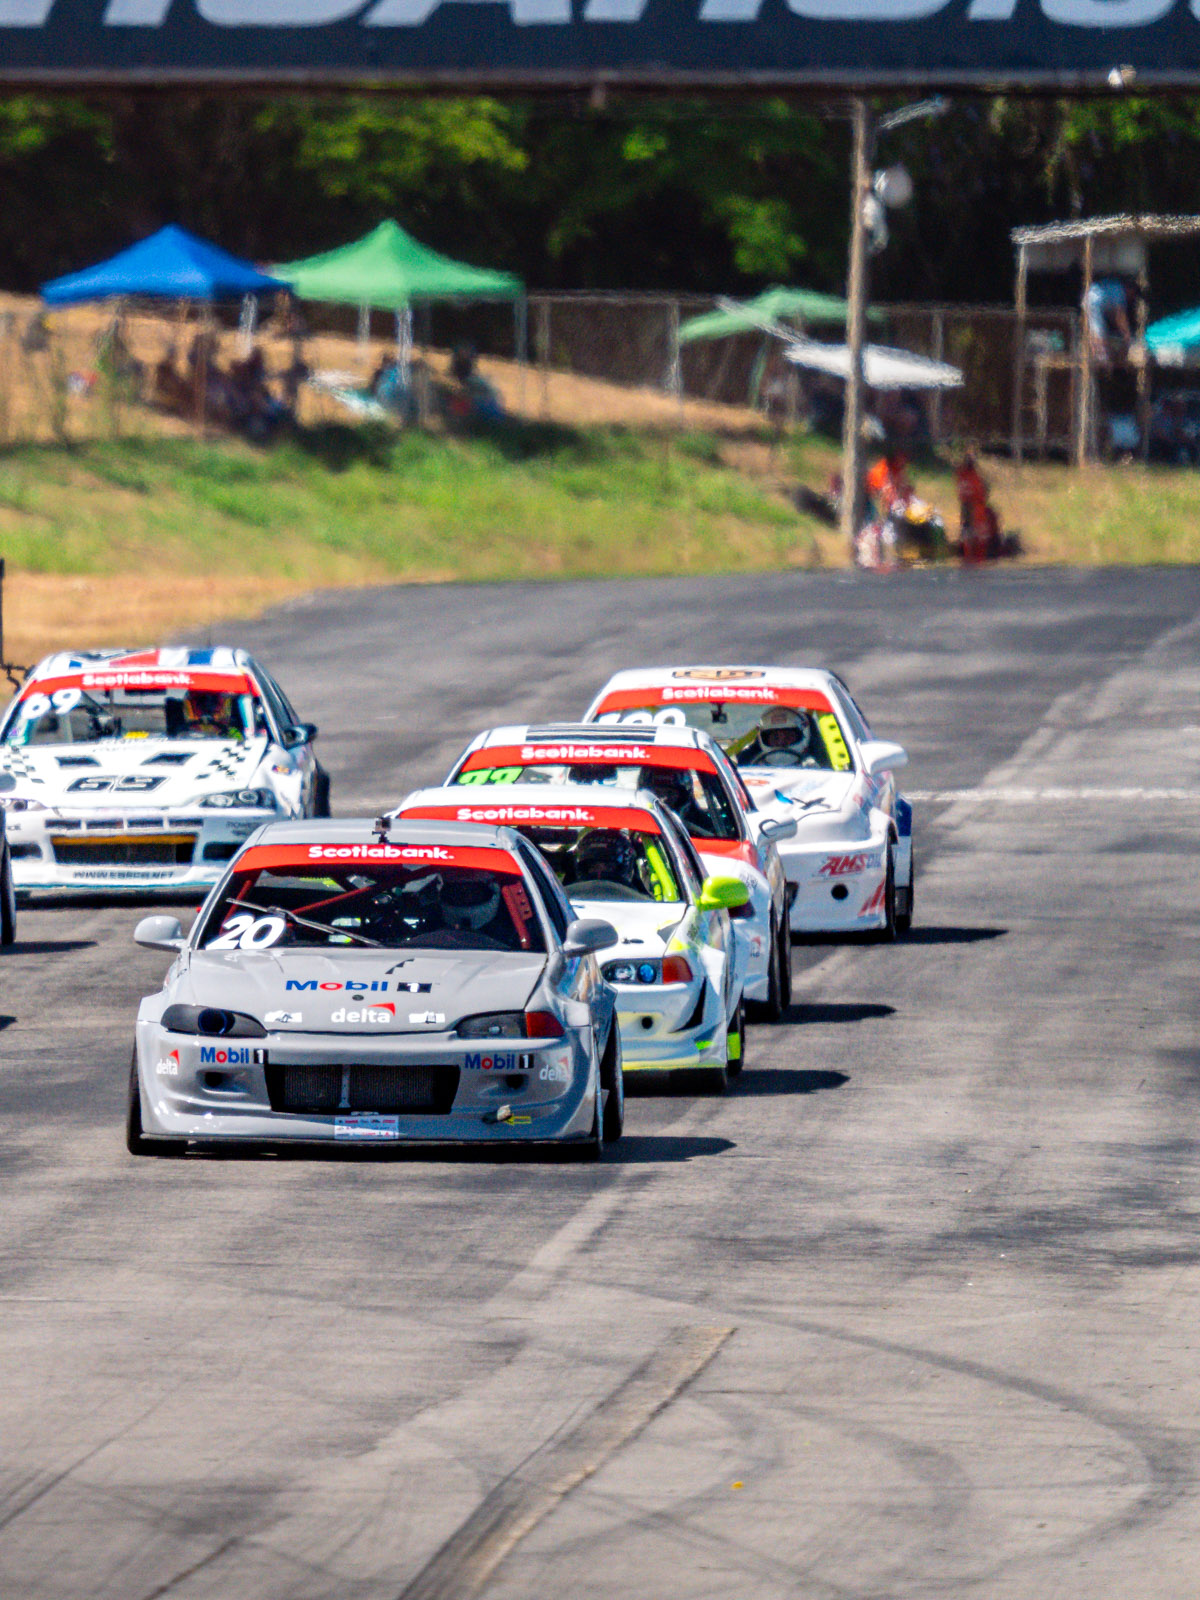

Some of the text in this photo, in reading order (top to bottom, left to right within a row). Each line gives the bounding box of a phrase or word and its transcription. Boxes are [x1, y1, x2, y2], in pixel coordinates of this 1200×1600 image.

[82, 672, 194, 685] Scotiabank.
[21, 688, 82, 720] 69
[521, 746, 650, 760] Scotiabank.
[64, 775, 171, 793] 69
[457, 807, 594, 821] Scotiabank.
[308, 845, 455, 860] Scotiabank.
[205, 915, 285, 950] 20
[285, 980, 388, 991] Mobil
[330, 1008, 391, 1023] delta
[200, 1047, 249, 1064] Mobil
[464, 1053, 515, 1069] Mobil
[156, 1058, 178, 1075] delta
